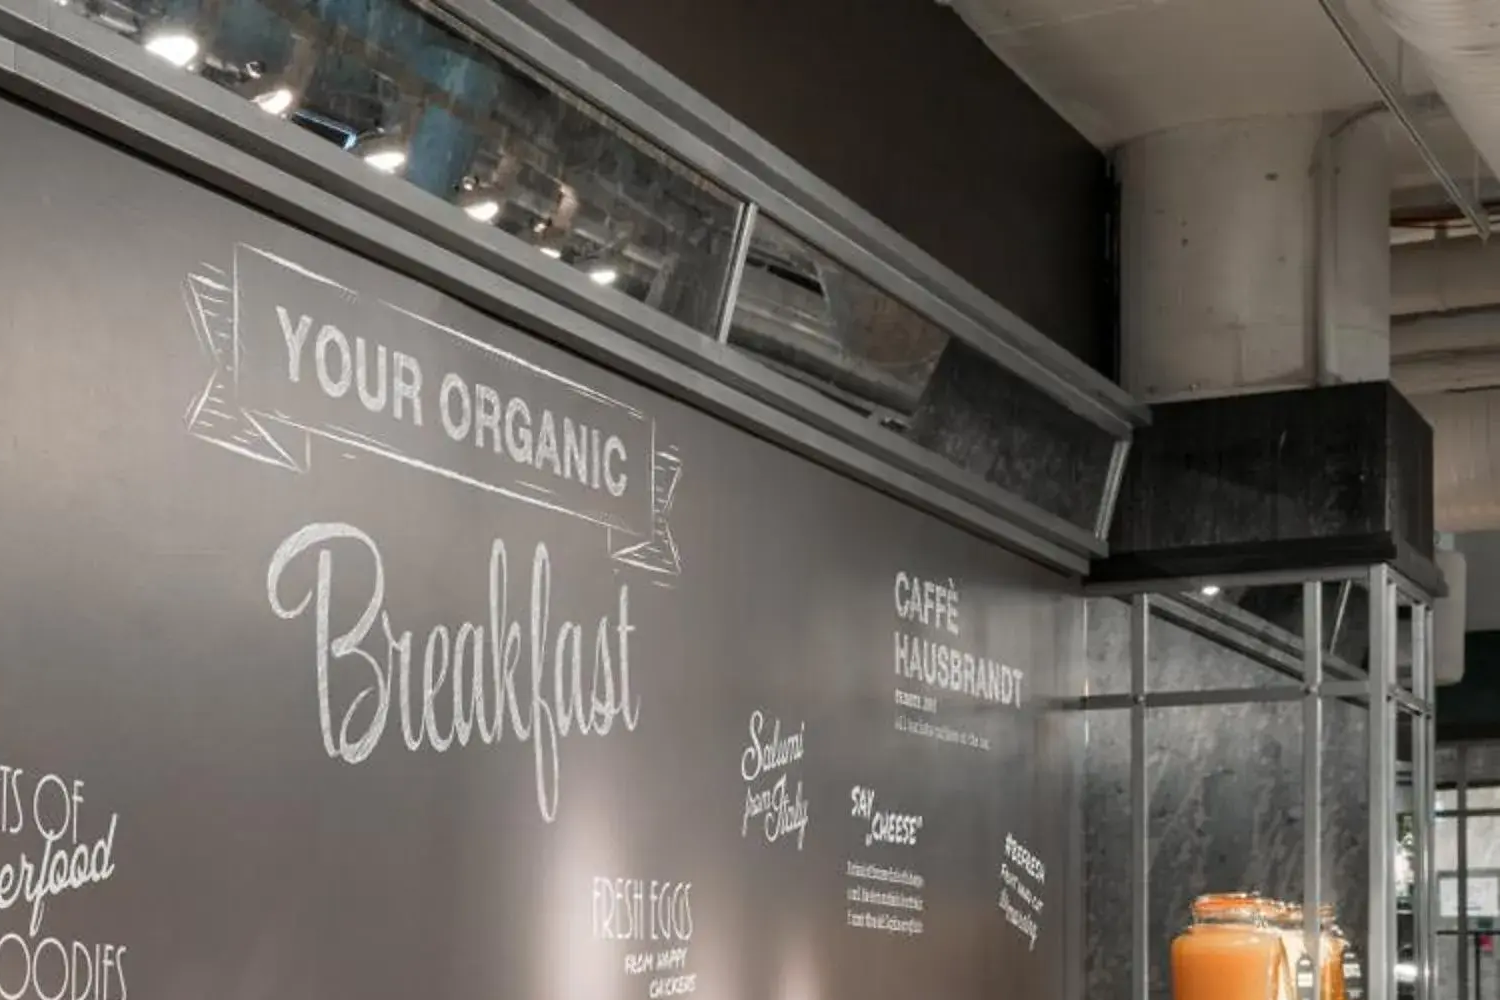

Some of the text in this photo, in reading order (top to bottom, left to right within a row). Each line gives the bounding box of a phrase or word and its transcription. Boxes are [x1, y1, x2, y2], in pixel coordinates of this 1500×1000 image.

[276, 305, 628, 496] YOUR ORGANIC
[267, 521, 641, 824] Breakfast
[894, 631, 1024, 711] HAUSBRANDT
[741, 710, 804, 781] Salumi
[33, 773, 85, 845] OF
[851, 785, 875, 819] SAY
[593, 877, 693, 940] FRESH EGGS
